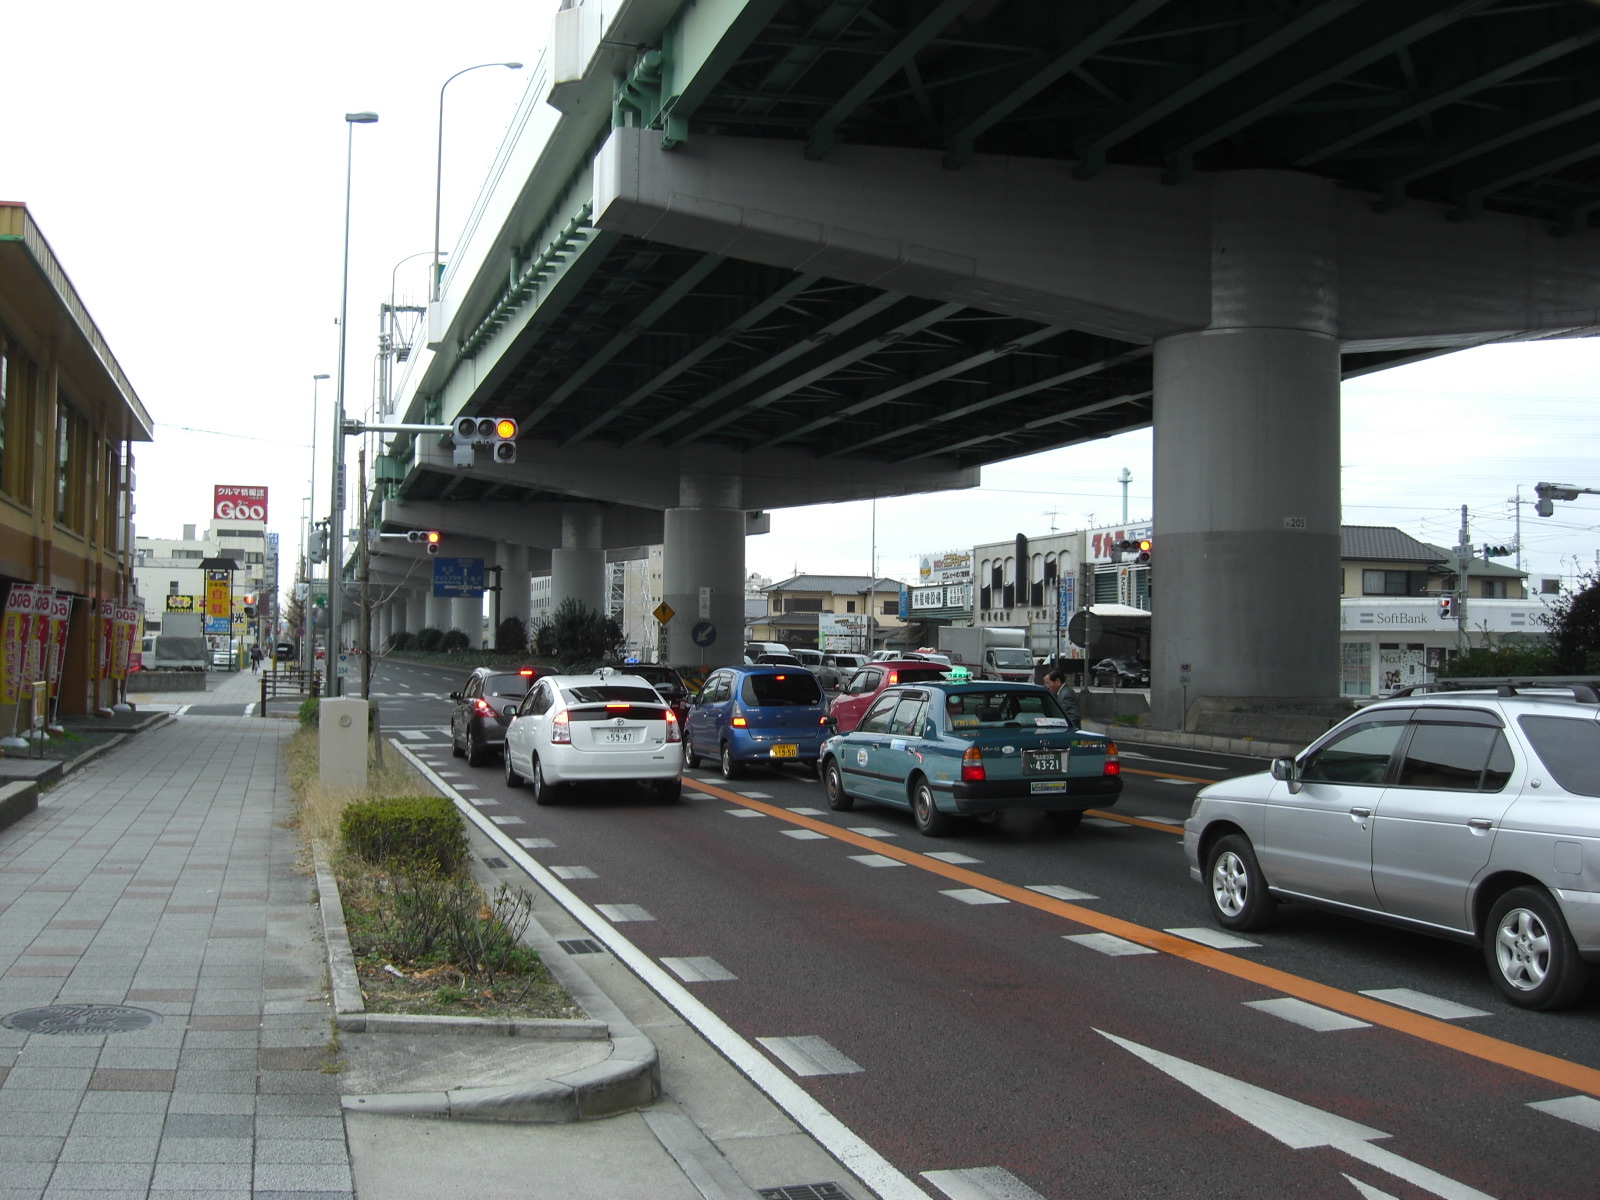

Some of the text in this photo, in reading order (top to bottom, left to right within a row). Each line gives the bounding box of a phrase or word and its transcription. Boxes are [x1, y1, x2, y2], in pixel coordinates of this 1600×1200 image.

[217, 487, 265, 497] クルマ情報誌
[217, 500, 265, 520] Goo
[1376, 612, 1427, 624] SoftBank
[1380, 654, 1401, 664] No.1
[610, 733, 632, 741] 59-47
[1035, 759, 1059, 770] 43-21
